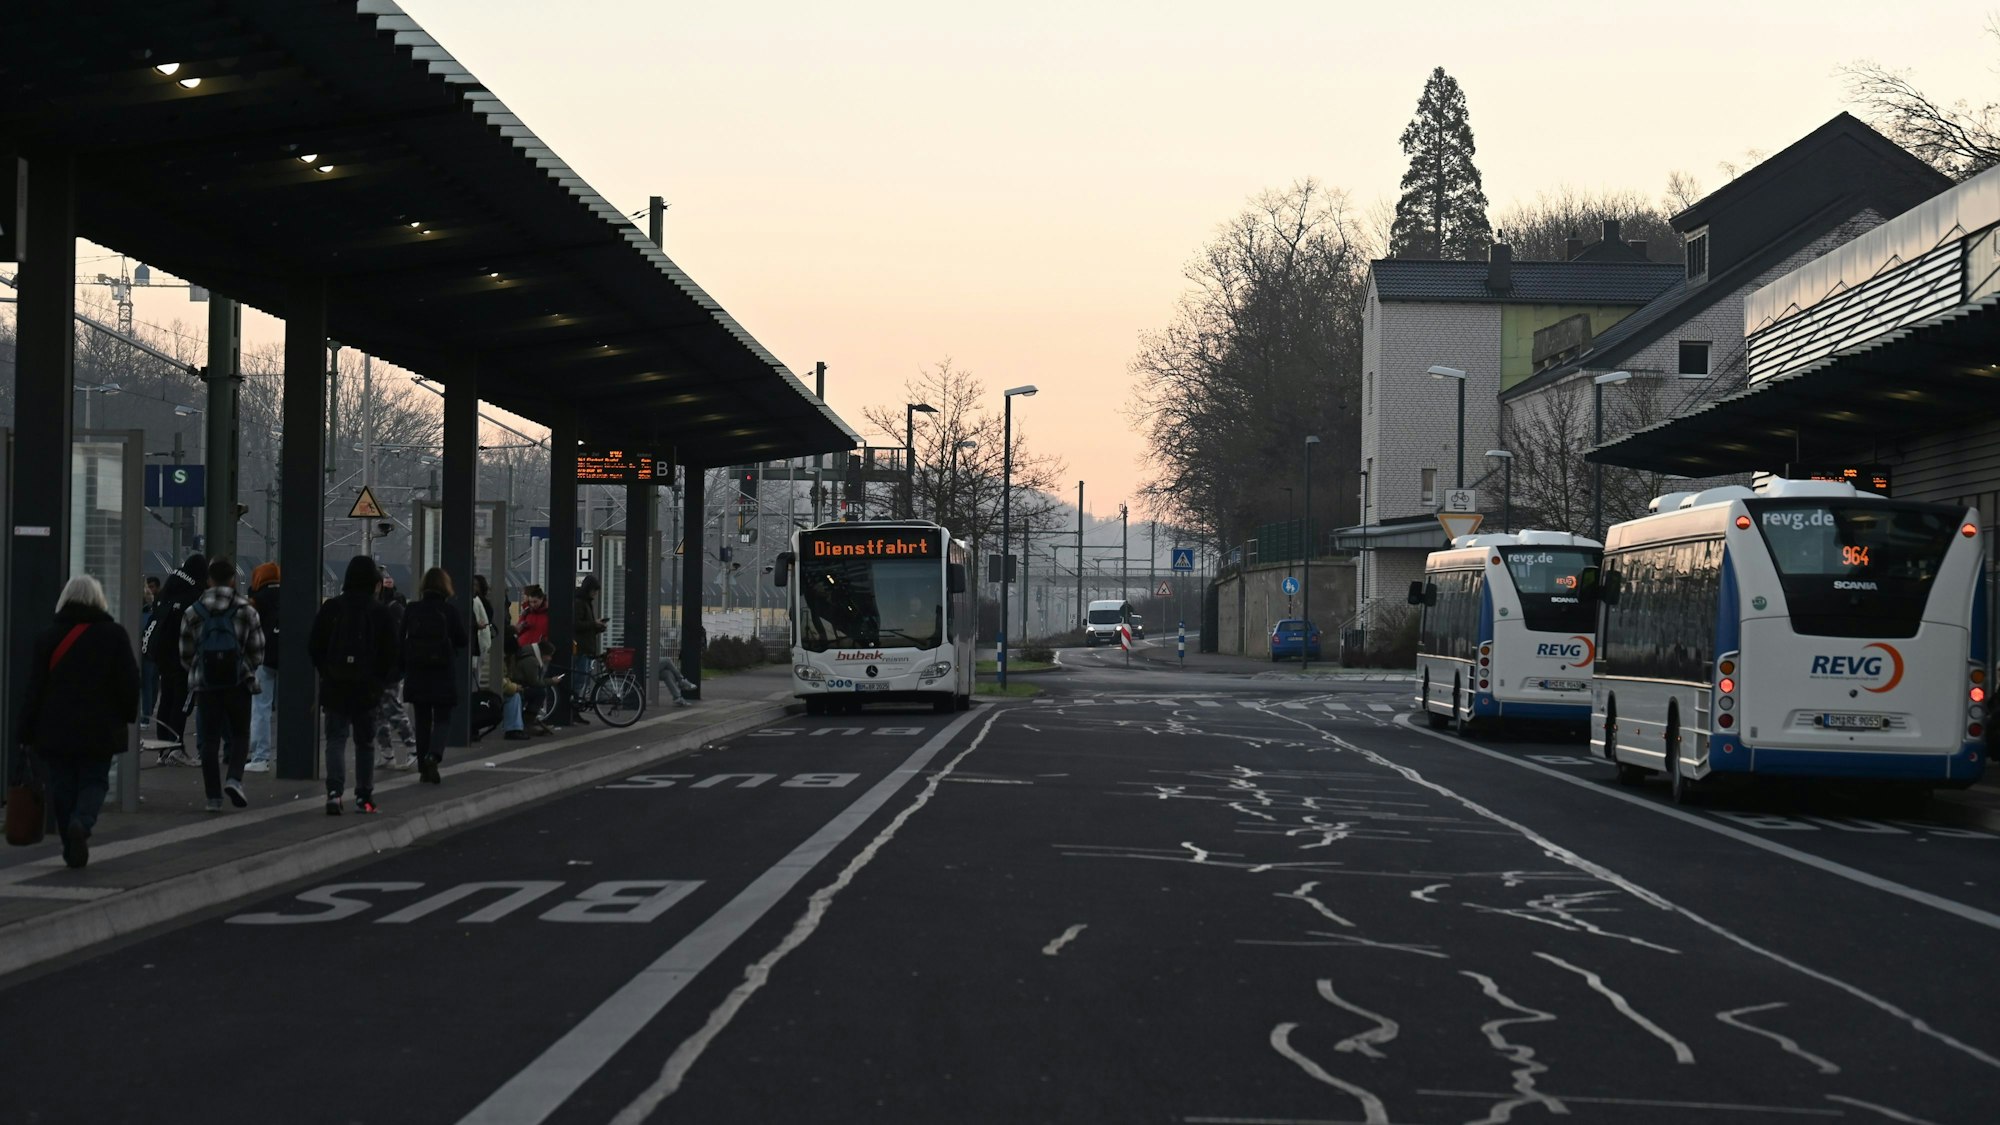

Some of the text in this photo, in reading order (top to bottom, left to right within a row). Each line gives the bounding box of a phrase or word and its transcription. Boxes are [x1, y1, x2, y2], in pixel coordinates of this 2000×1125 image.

[174, 469, 186, 484] S
[656, 461, 669, 477] B
[1762, 509, 1835, 530] revg.de
[814, 538, 928, 556] Dienstfahrt
[579, 549, 592, 570] H
[1508, 552, 1553, 565] revg.de
[1842, 545, 1870, 566] 964
[1834, 580, 1878, 590] SCANIA
[141, 619, 158, 655] adidas
[835, 650, 884, 661] bubak
[1537, 643, 1582, 657] REVG
[1811, 655, 1883, 676] REVG
[747, 727, 926, 736] BUS
[606, 773, 862, 789] BUS
[224, 879, 706, 925] BUS
